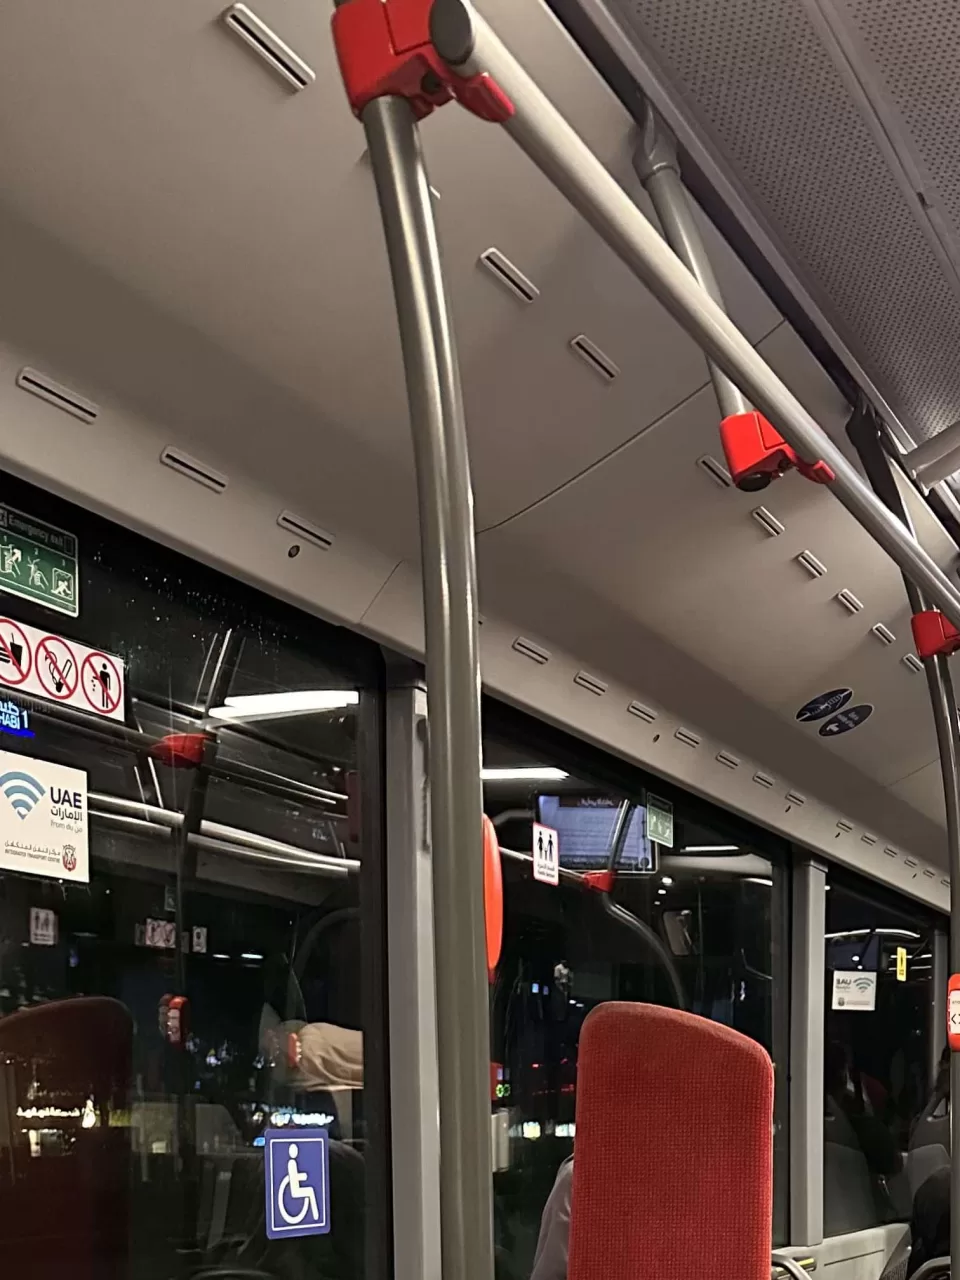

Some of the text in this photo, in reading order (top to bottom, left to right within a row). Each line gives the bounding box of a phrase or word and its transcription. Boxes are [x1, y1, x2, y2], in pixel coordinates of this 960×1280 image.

[8, 513, 49, 544] Emergency
[0, 712, 20, 730] HABI
[50, 786, 82, 810] UAE
[50, 806, 83, 824] الإمارات
